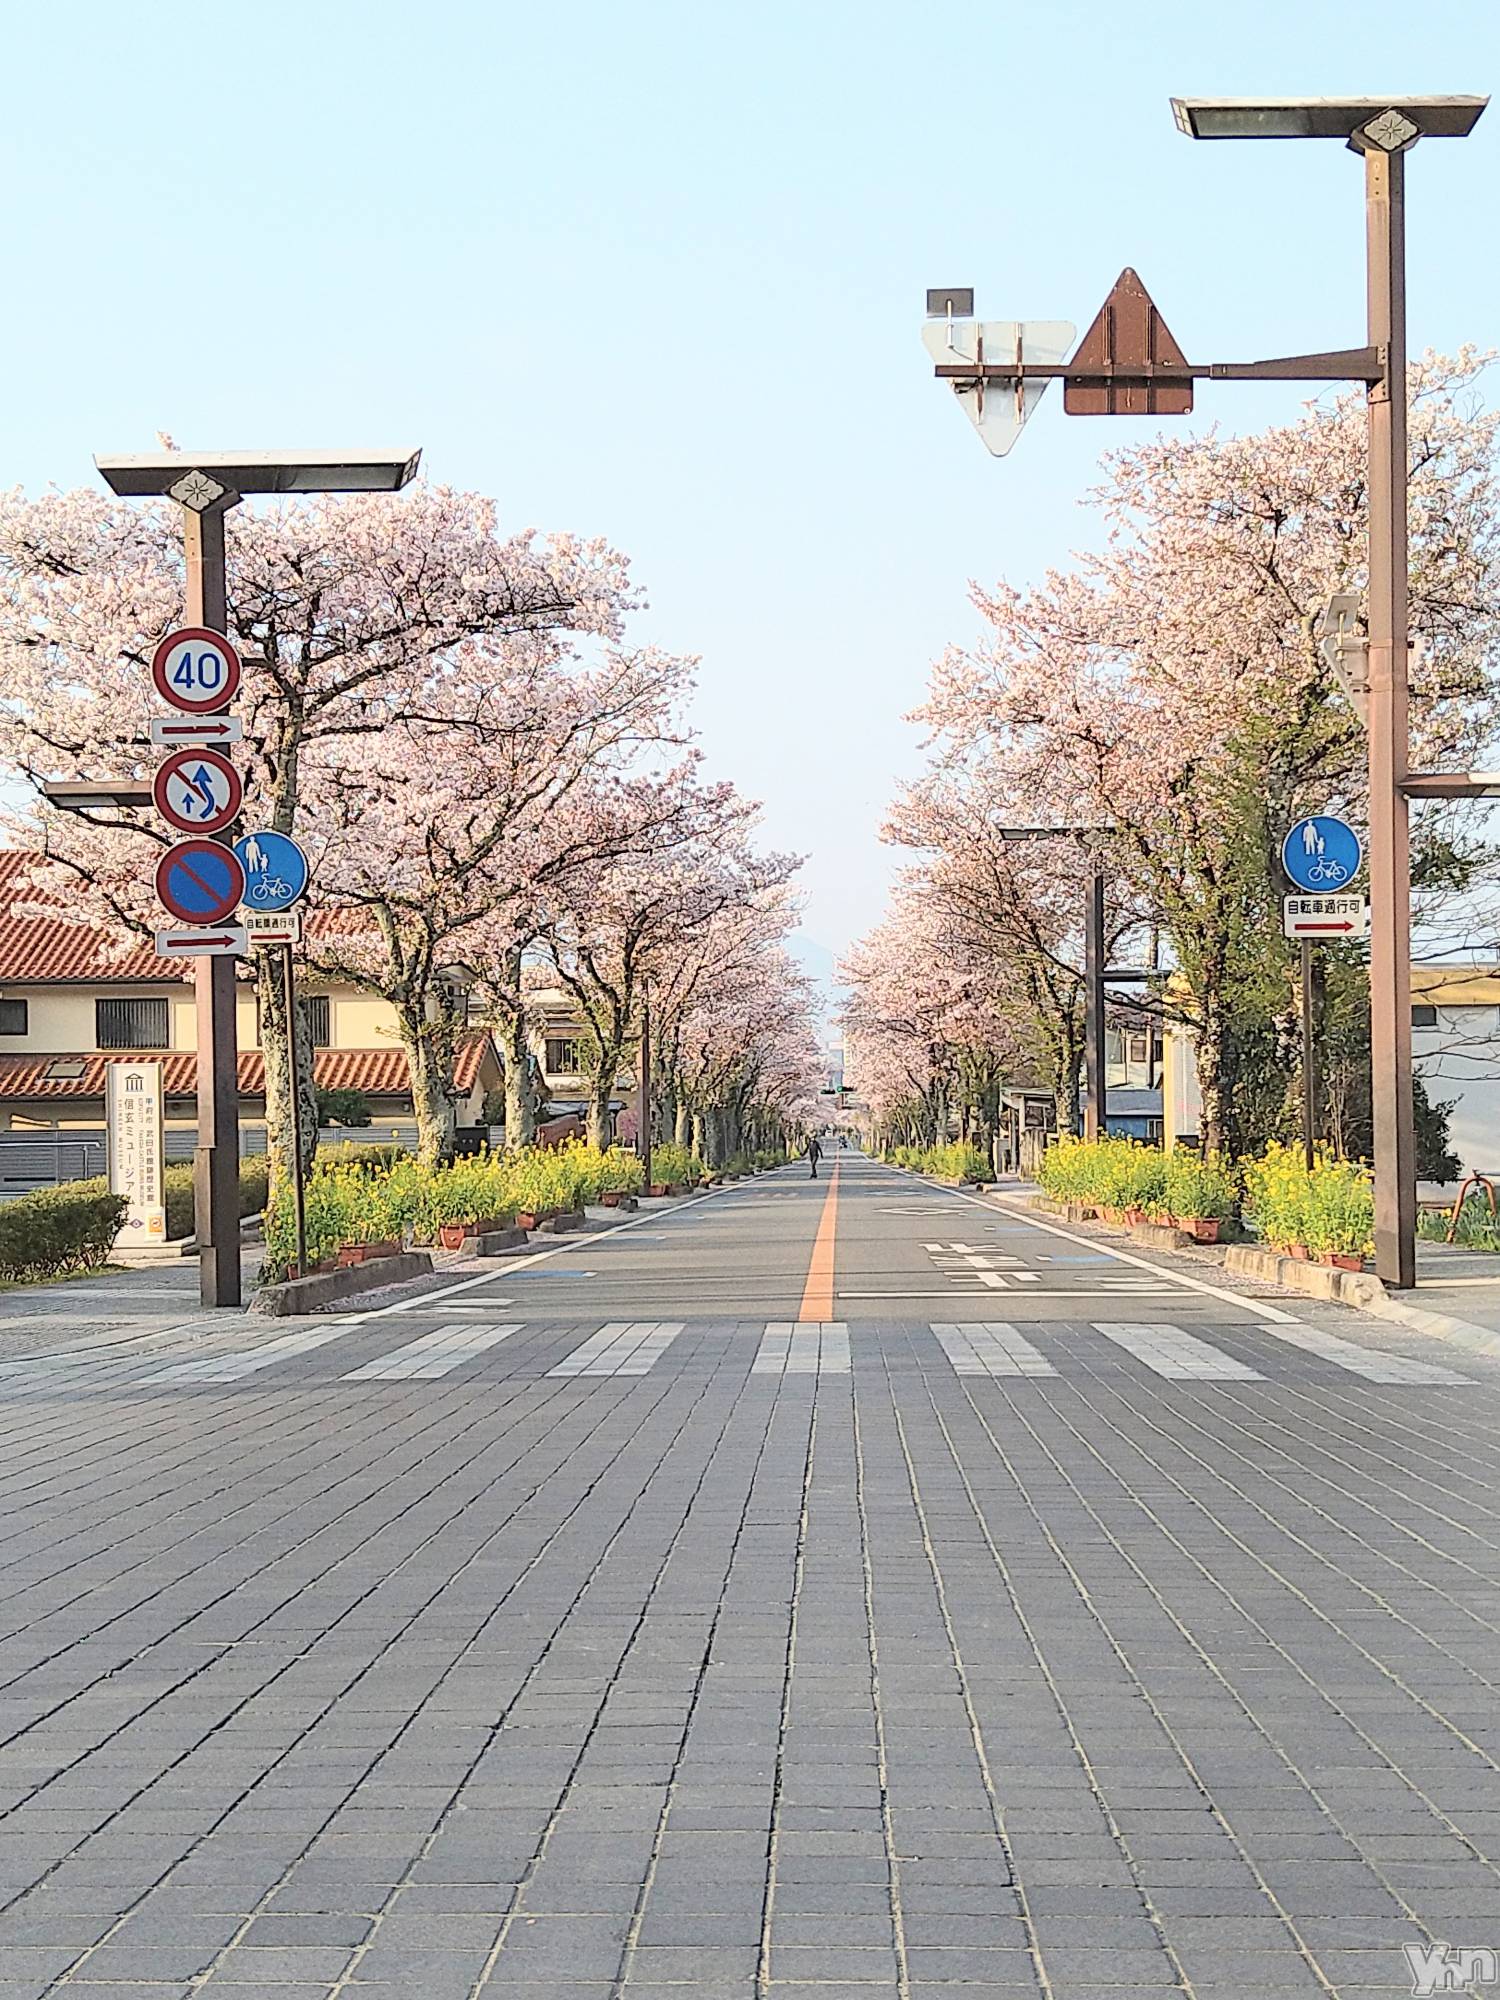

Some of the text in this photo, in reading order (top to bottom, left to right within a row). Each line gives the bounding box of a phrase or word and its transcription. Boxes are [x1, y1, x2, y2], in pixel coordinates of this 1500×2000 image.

[173, 652, 221, 689] 40
[1288, 899, 1360, 914] 自転車通行可
